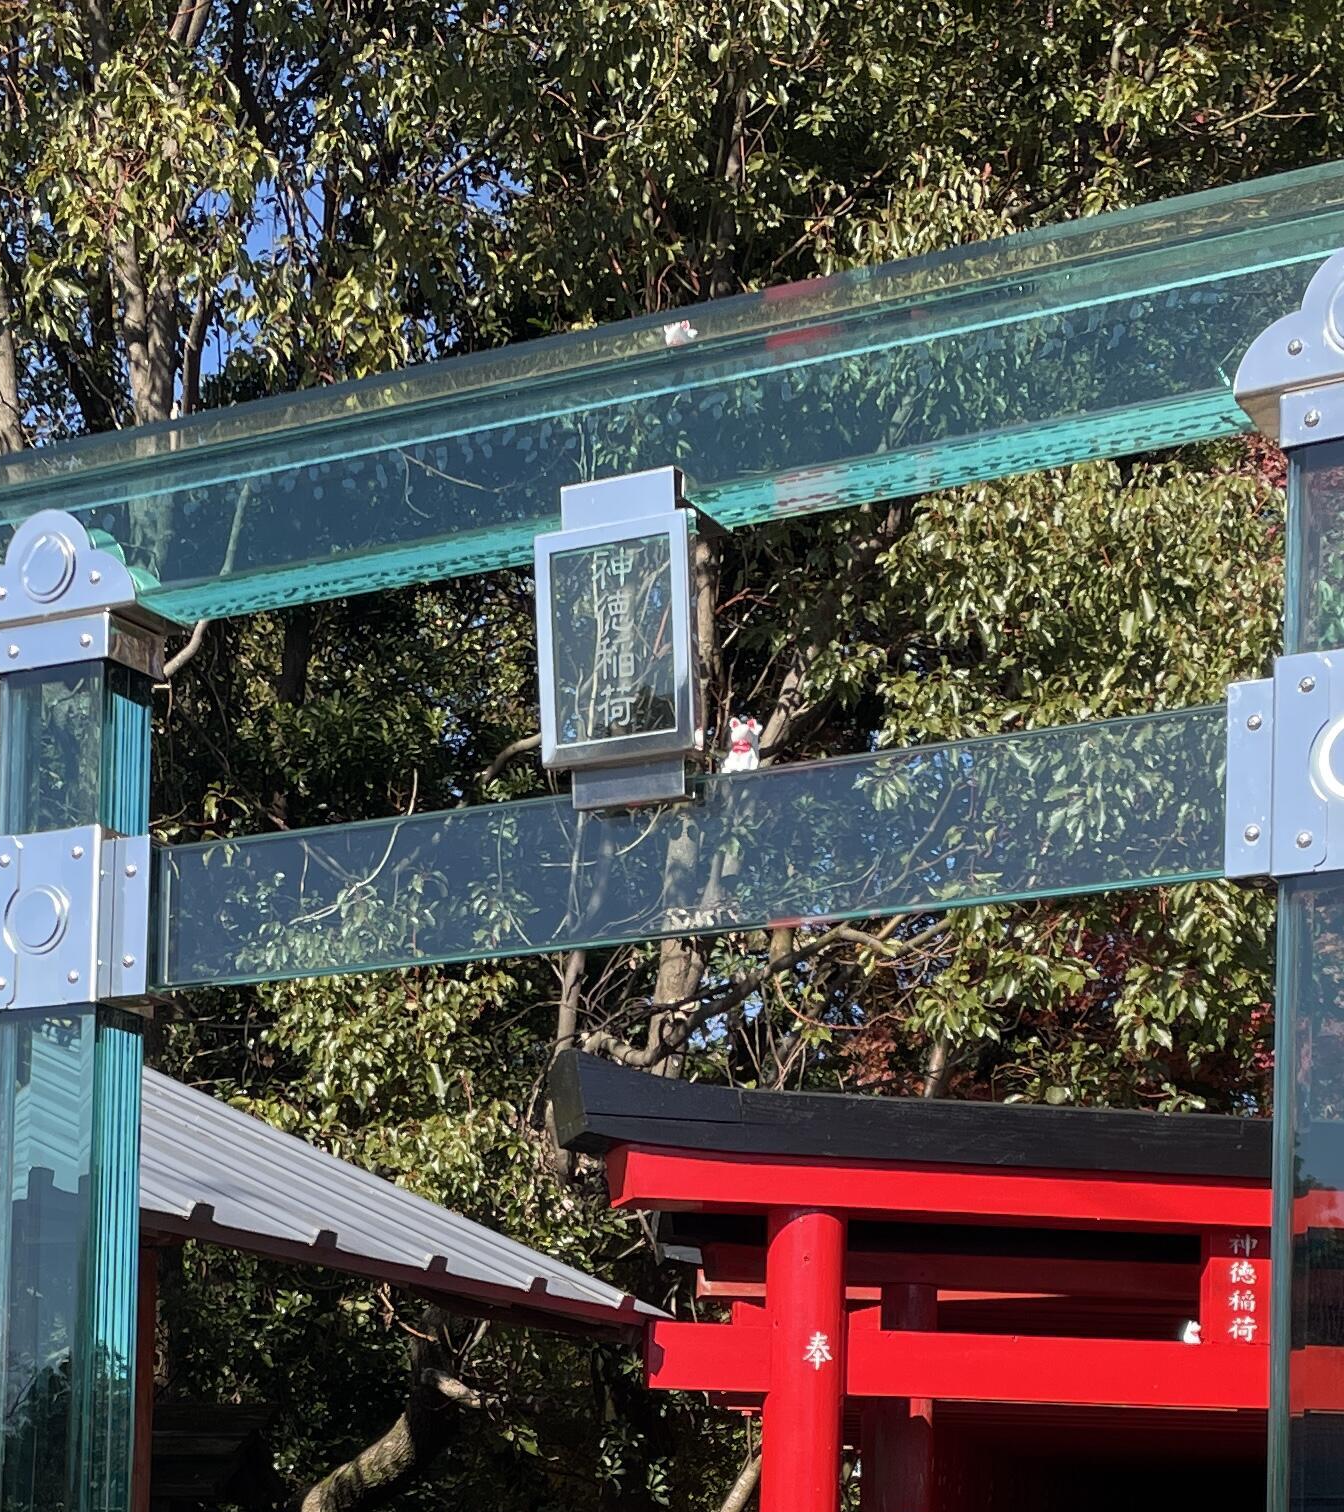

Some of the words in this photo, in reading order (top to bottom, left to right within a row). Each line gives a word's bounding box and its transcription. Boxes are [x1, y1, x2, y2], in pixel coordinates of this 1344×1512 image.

[592, 547, 638, 728] 神徳稲荷
[1227, 1233, 1258, 1343] 神徳稲荷
[803, 1331, 833, 1370] 奉
